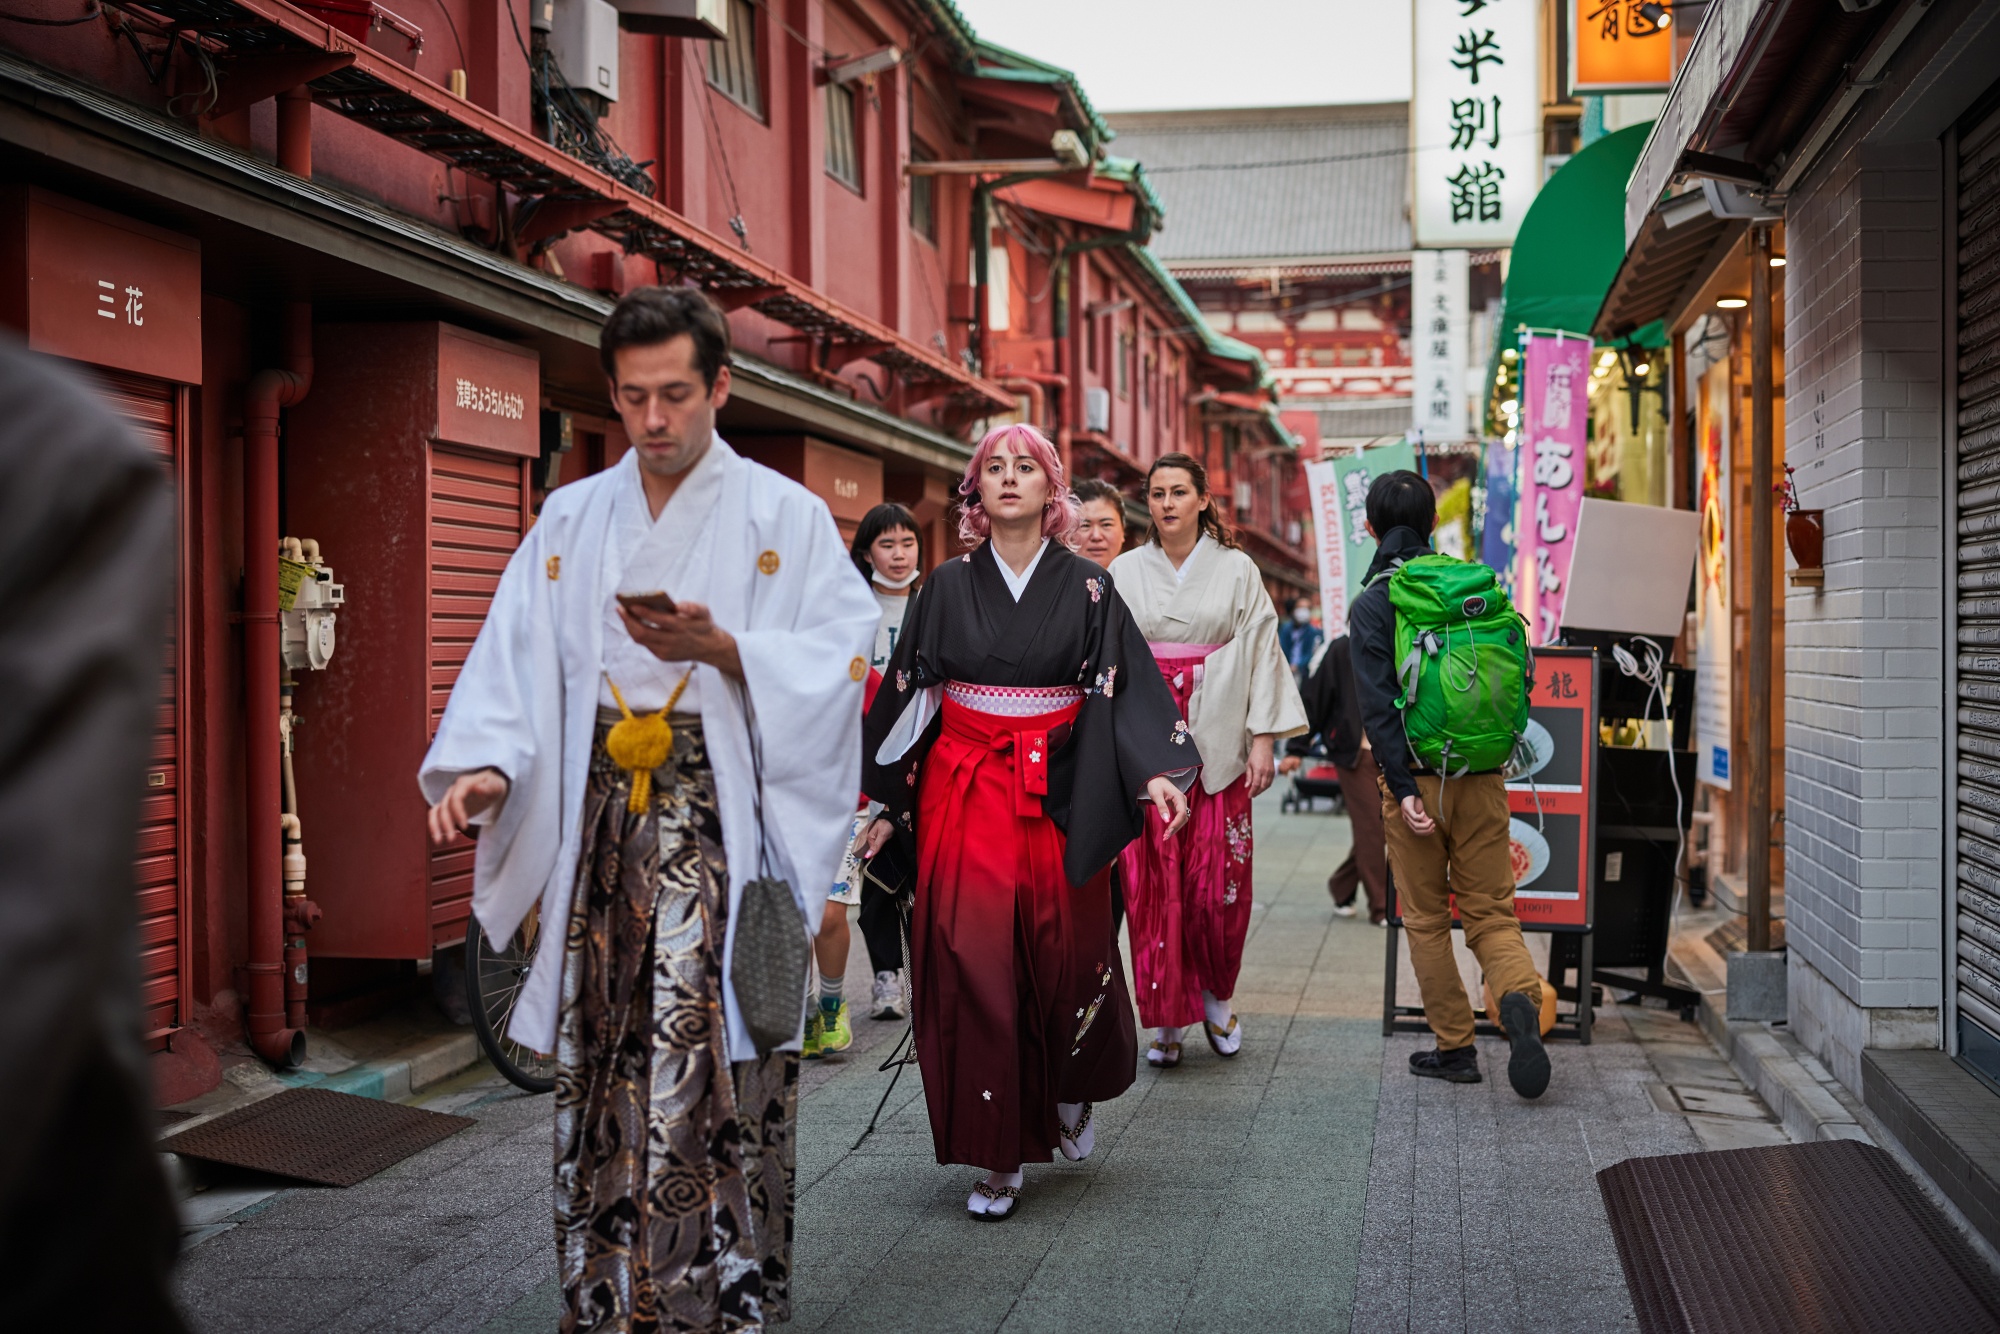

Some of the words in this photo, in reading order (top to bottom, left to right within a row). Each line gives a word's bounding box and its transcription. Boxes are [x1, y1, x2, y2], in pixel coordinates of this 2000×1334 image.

[1446, 0, 1505, 223] 半別舘
[98, 280, 144, 326] 三花
[456, 377, 525, 420] 浅草ちょうちんもなか
[1545, 671, 1578, 699] 龍
